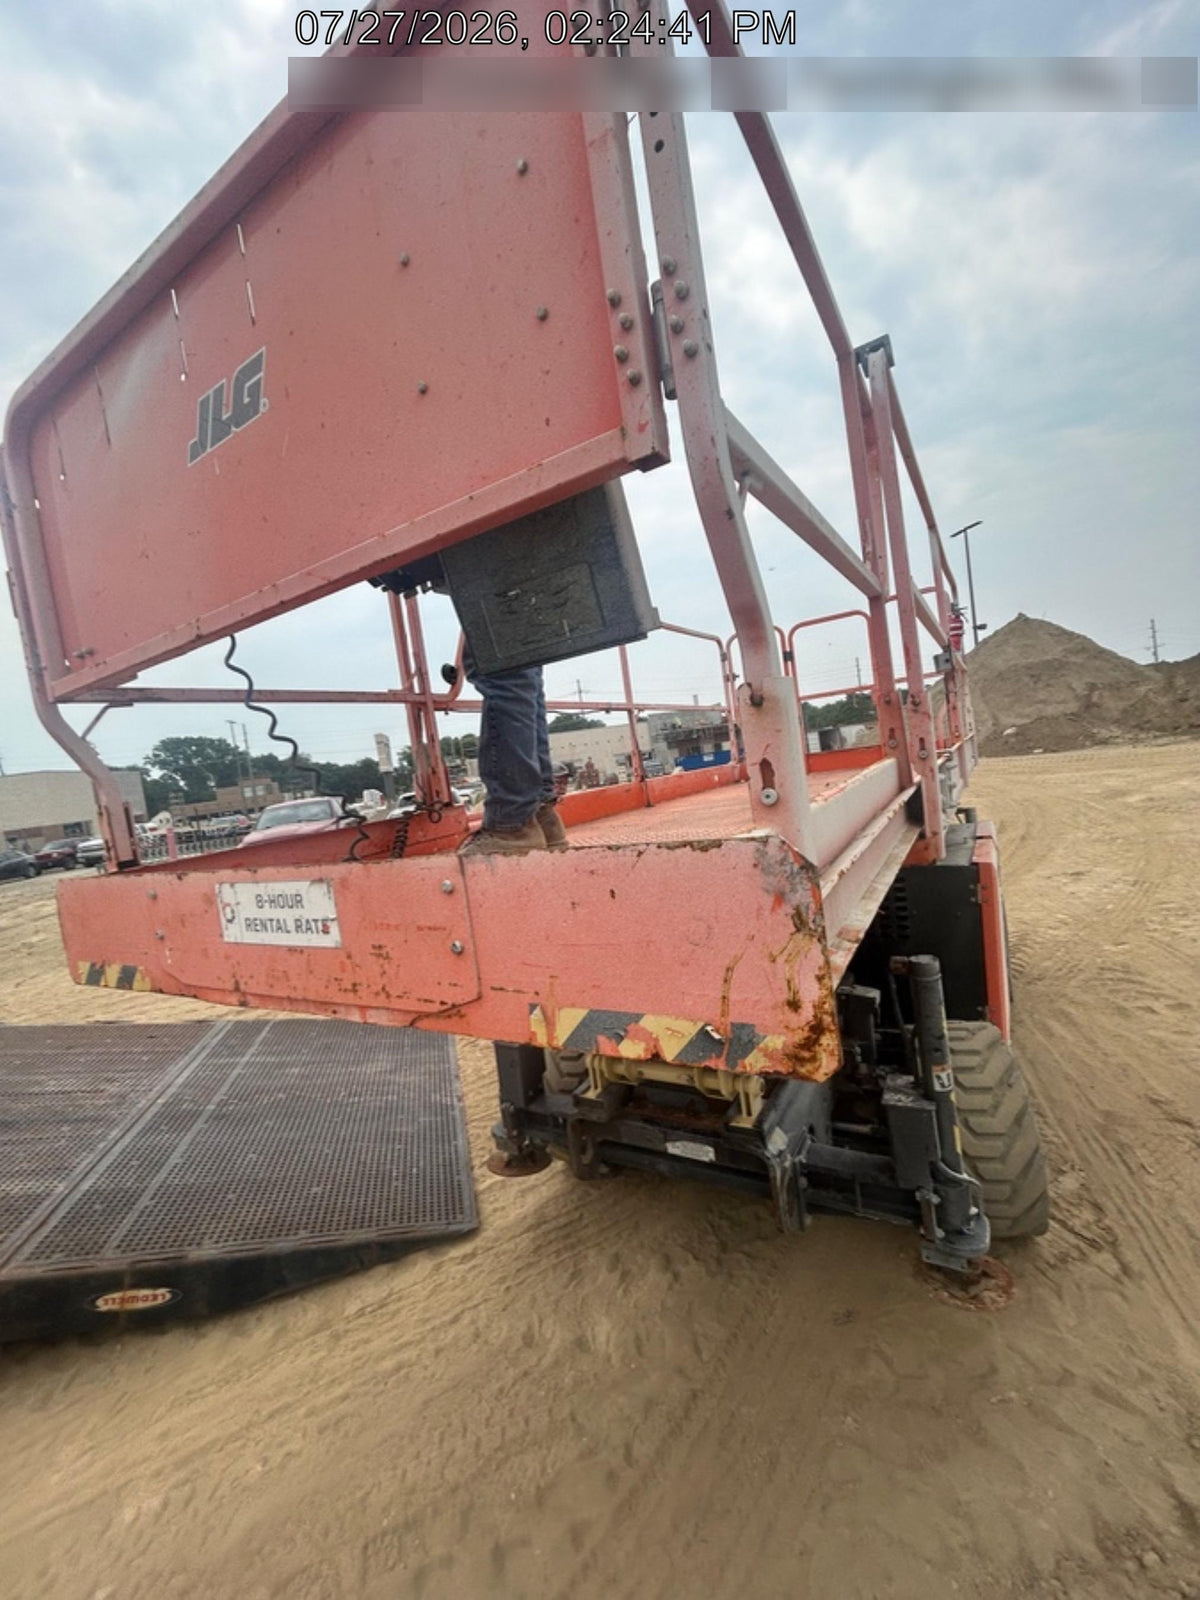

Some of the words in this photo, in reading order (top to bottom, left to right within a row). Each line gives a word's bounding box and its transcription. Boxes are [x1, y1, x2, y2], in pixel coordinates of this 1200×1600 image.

[187, 345, 266, 467] JLG
[255, 893, 304, 909] 8-HOUR
[244, 917, 291, 934] RENTAL
